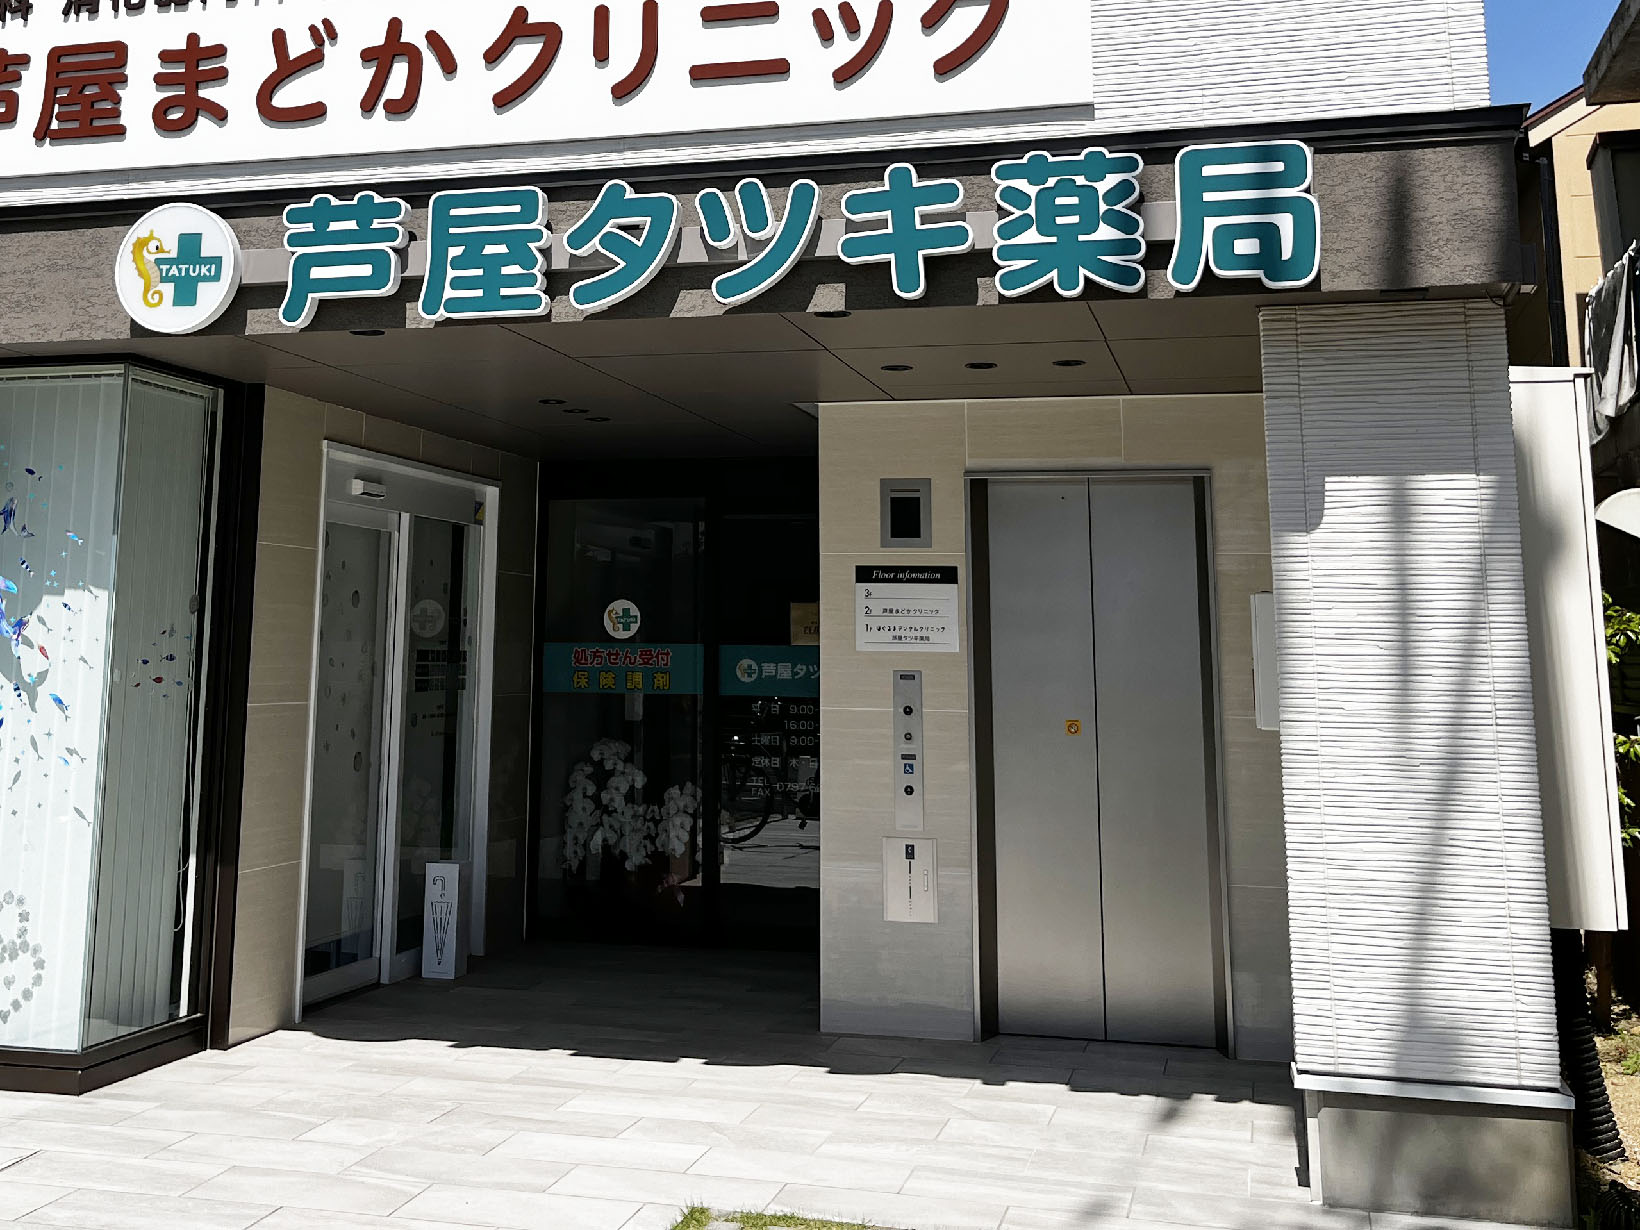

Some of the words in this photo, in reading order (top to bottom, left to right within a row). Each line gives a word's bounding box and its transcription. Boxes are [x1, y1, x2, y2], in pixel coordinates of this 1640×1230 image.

[278, 139, 1322, 330] 芦屋タツキ薬局
[159, 262, 217, 278] TATUKI
[572, 648, 672, 667] 処方せん受付
